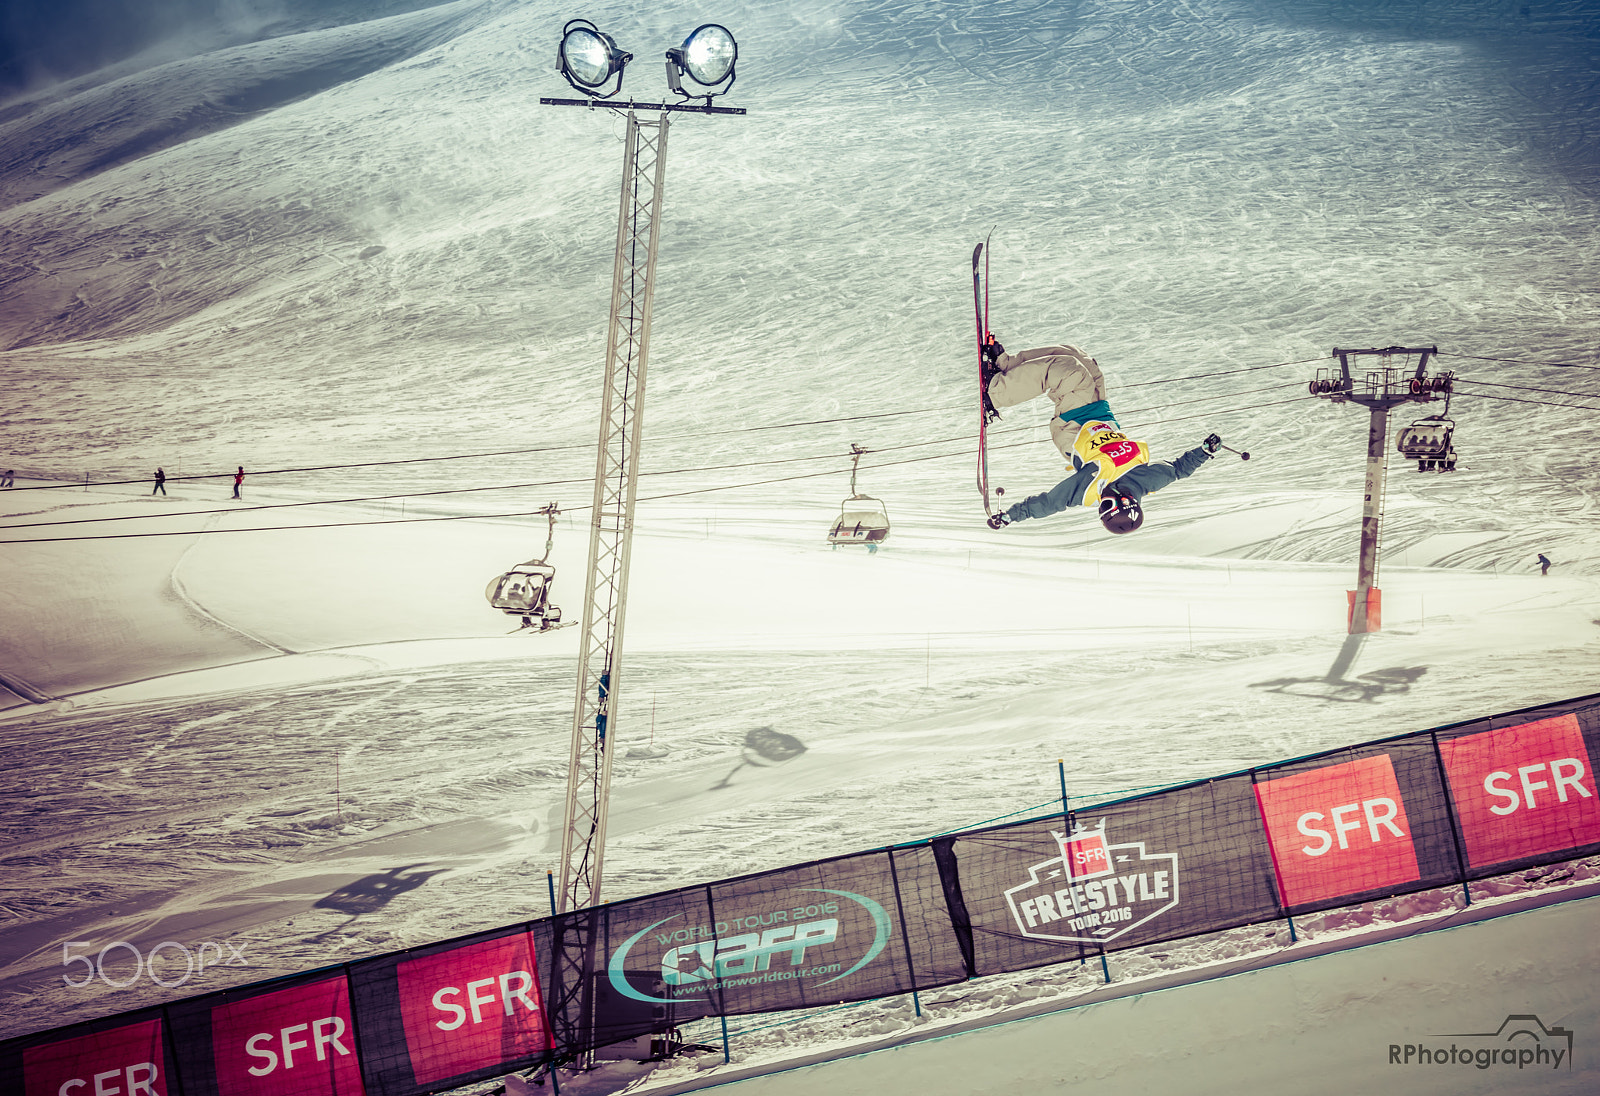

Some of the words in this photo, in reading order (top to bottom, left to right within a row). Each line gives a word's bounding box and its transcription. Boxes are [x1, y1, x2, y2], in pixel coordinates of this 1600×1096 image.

[1107, 441, 1132, 458] SFR
[1484, 757, 1592, 816] SFR
[1297, 797, 1405, 856] SFR
[1075, 847, 1106, 865] SFR
[655, 921, 729, 946] WORLD
[732, 910, 788, 930] TOUR
[793, 901, 839, 920] 2016
[1020, 870, 1169, 928] FREESTYLE
[1068, 912, 1100, 932] TOUR
[1099, 907, 1132, 925] 2016
[432, 970, 539, 1031] SFR
[672, 963, 842, 998] www.afpworldtour.com
[245, 1016, 351, 1077] SFR
